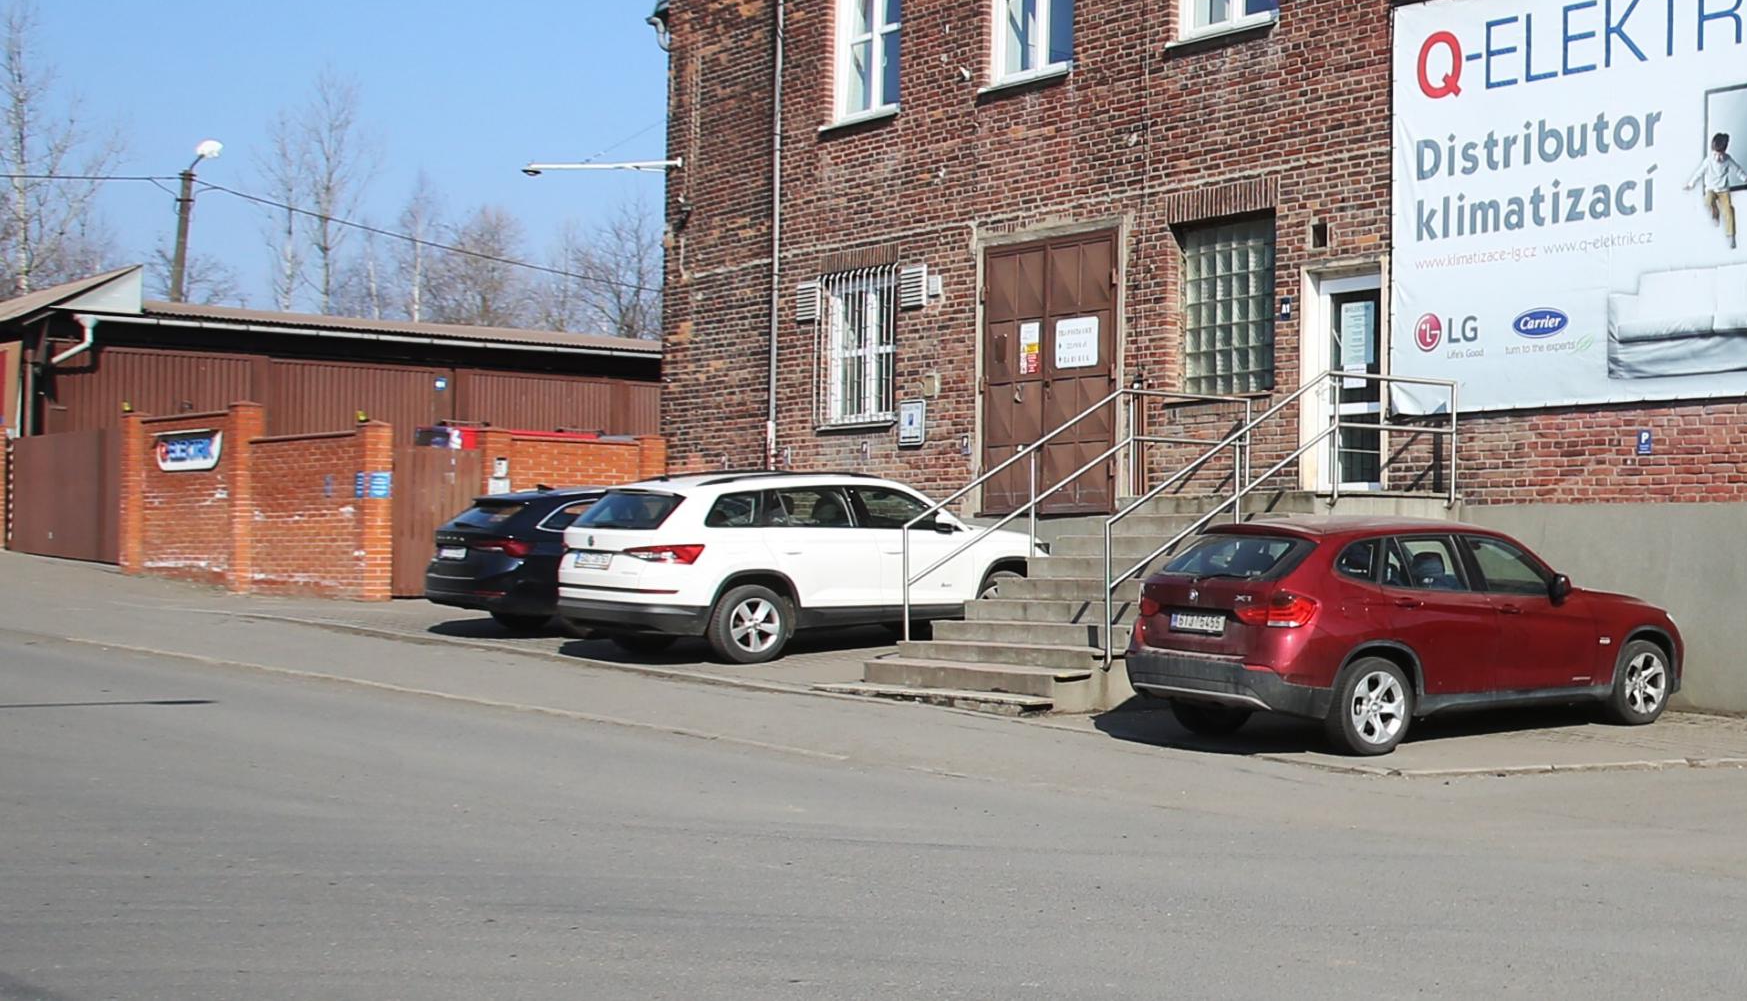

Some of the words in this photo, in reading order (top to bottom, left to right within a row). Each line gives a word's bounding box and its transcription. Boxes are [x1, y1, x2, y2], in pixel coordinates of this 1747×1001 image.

[1416, 110, 1663, 182] Distributor
[1416, 163, 1658, 243] klimatizací
[1415, 245, 1537, 271] www.klimatizace-lg.cz
[1543, 231, 1654, 255] www.q-elektrik.cz
[1281, 303, 1290, 314] A1
[1447, 315, 1478, 344] LG
[1520, 314, 1562, 331] Carrier
[1465, 348, 1485, 359] Good
[1521, 344, 1531, 354] to
[1532, 343, 1545, 353] the
[1546, 341, 1576, 353] experts
